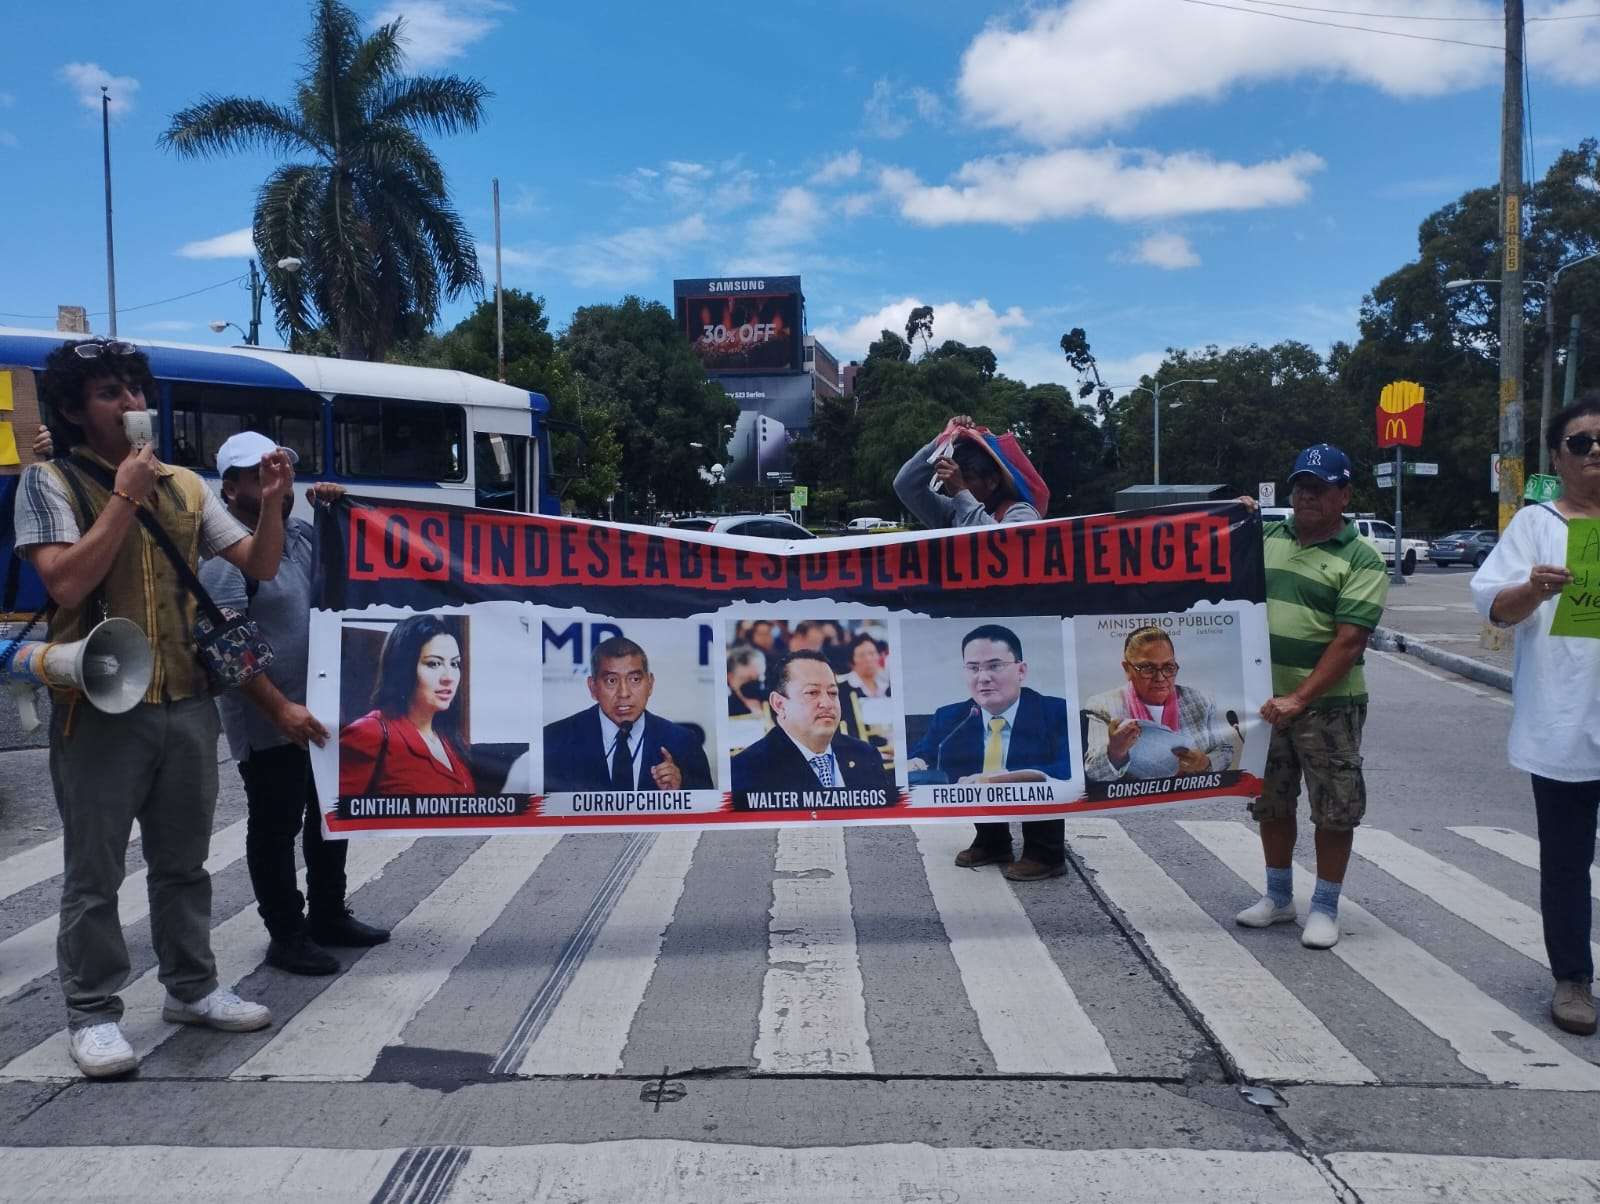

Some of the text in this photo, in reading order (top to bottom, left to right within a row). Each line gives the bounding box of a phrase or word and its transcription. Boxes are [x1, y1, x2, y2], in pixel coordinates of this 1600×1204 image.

[708, 280, 765, 292] SAMSUNG
[702, 323, 776, 344] 30% OFF
[356, 515, 1227, 583] LOS INDESEABLES DE LA LISTA ENGEL
[1097, 614, 1234, 631] MINISTERIO PÚBLICO
[933, 785, 1055, 804] FREDDY ORELLANA
[1107, 773, 1222, 798] CONSUELO PORRAS
[350, 796, 516, 816] CINTHIA MONTERROSO
[572, 791, 692, 813] CURRUPCHICHE
[747, 788, 887, 809] WALTER MAZARIEGOS
